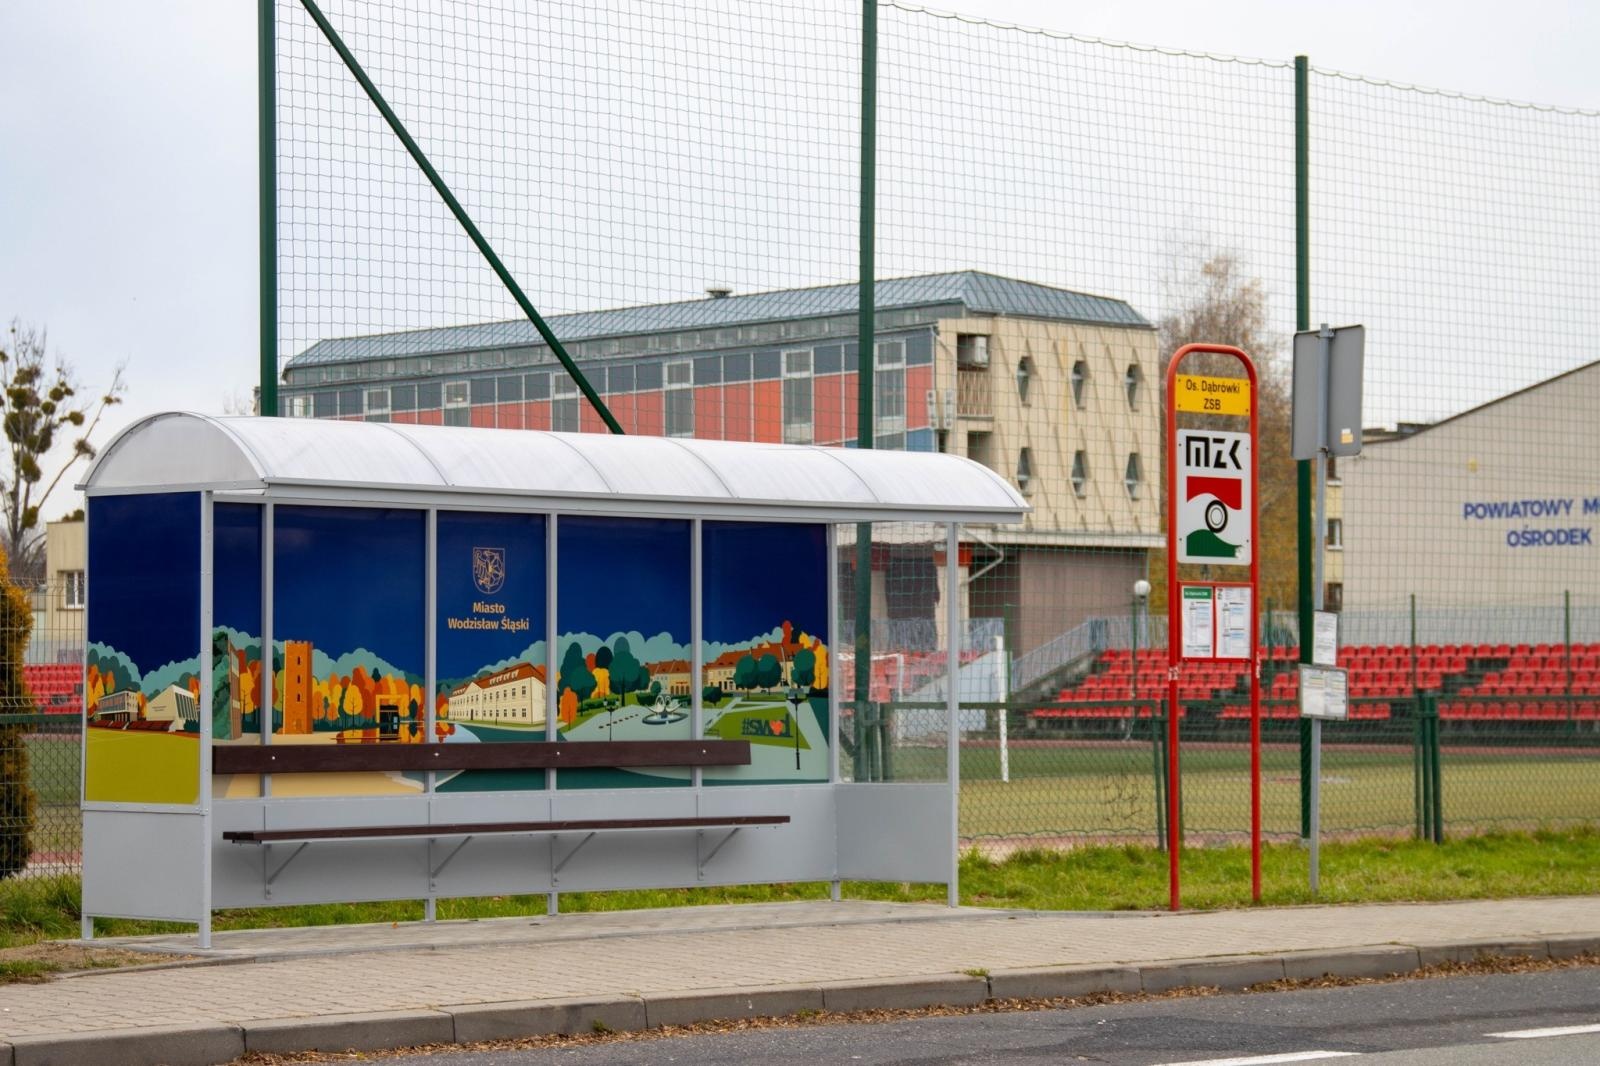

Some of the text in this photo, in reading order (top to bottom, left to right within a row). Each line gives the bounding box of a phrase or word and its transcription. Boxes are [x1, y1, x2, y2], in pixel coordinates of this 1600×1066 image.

[1185, 378, 1240, 395] Os. Dąbrówki
[1203, 398, 1221, 410] ZSB
[1186, 435, 1242, 470] MZK
[1463, 498, 1573, 520] POWIATOWY
[1507, 524, 1592, 547] OŚRODEK
[472, 601, 505, 613] Miasto
[448, 615, 530, 633] Wodzisław Śląski
